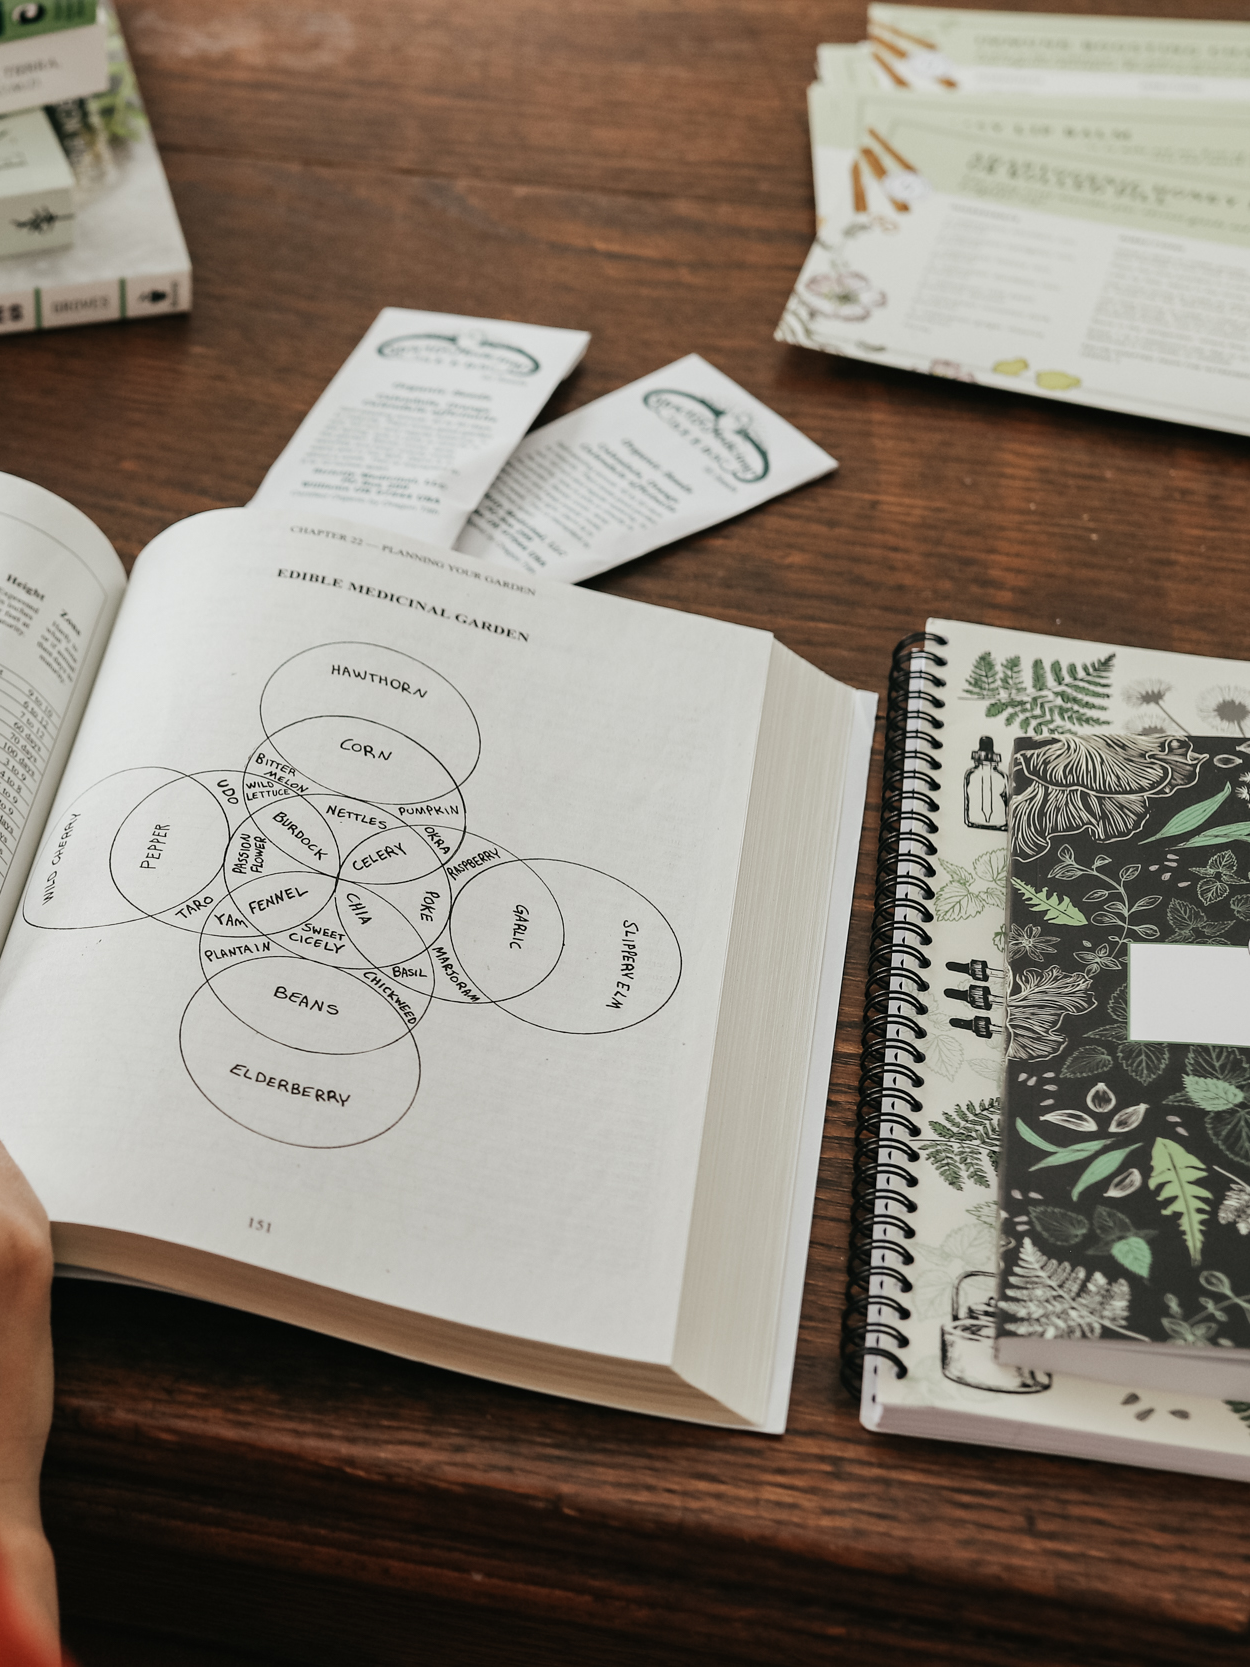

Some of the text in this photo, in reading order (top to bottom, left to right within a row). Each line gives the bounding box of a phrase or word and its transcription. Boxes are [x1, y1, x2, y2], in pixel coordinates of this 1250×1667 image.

[290, 526, 536, 596] CHAPTER 22 PLANNING YOUR GARDEN
[277, 568, 530, 642] EDIBLE MEDICINAL GARDEN
[332, 664, 428, 698] HAWTHORN
[340, 738, 392, 761] CORN
[255, 753, 296, 777] BITTER
[217, 779, 239, 805] UDO
[246, 781, 274, 789] WILD
[246, 789, 290, 801] LETTUCE
[264, 771, 309, 793] MELON
[326, 805, 387, 829] NETTLES
[399, 806, 459, 816] PUMPKIN
[140, 823, 170, 869] PEPPER
[273, 812, 328, 861] BURDOCK
[424, 826, 450, 855] OKRA
[42, 813, 81, 905] WILD CHERRY
[232, 834, 251, 874] PASSION
[251, 836, 266, 873] FLOWER
[352, 842, 407, 871] CELERY
[446, 847, 501, 881] RASPBERRY
[175, 895, 213, 919] TARO
[249, 887, 308, 914] FENNEL
[347, 893, 372, 925] CHIA
[420, 891, 440, 922] POKE
[215, 913, 248, 928] YAM
[301, 923, 346, 941] SWEET
[509, 904, 529, 949] GARLIC
[205, 942, 271, 962] PLANTAIN
[289, 933, 346, 953] CICELY
[392, 966, 427, 978] BASIL
[432, 946, 481, 1004] MARJORAM
[605, 920, 639, 1009] SLIPPERY ELM
[273, 986, 339, 1015] BEANS
[363, 971, 417, 1025] CHICKWEED
[230, 1064, 351, 1107] ELDERBERRY
[249, 1217, 271, 1233] 151
